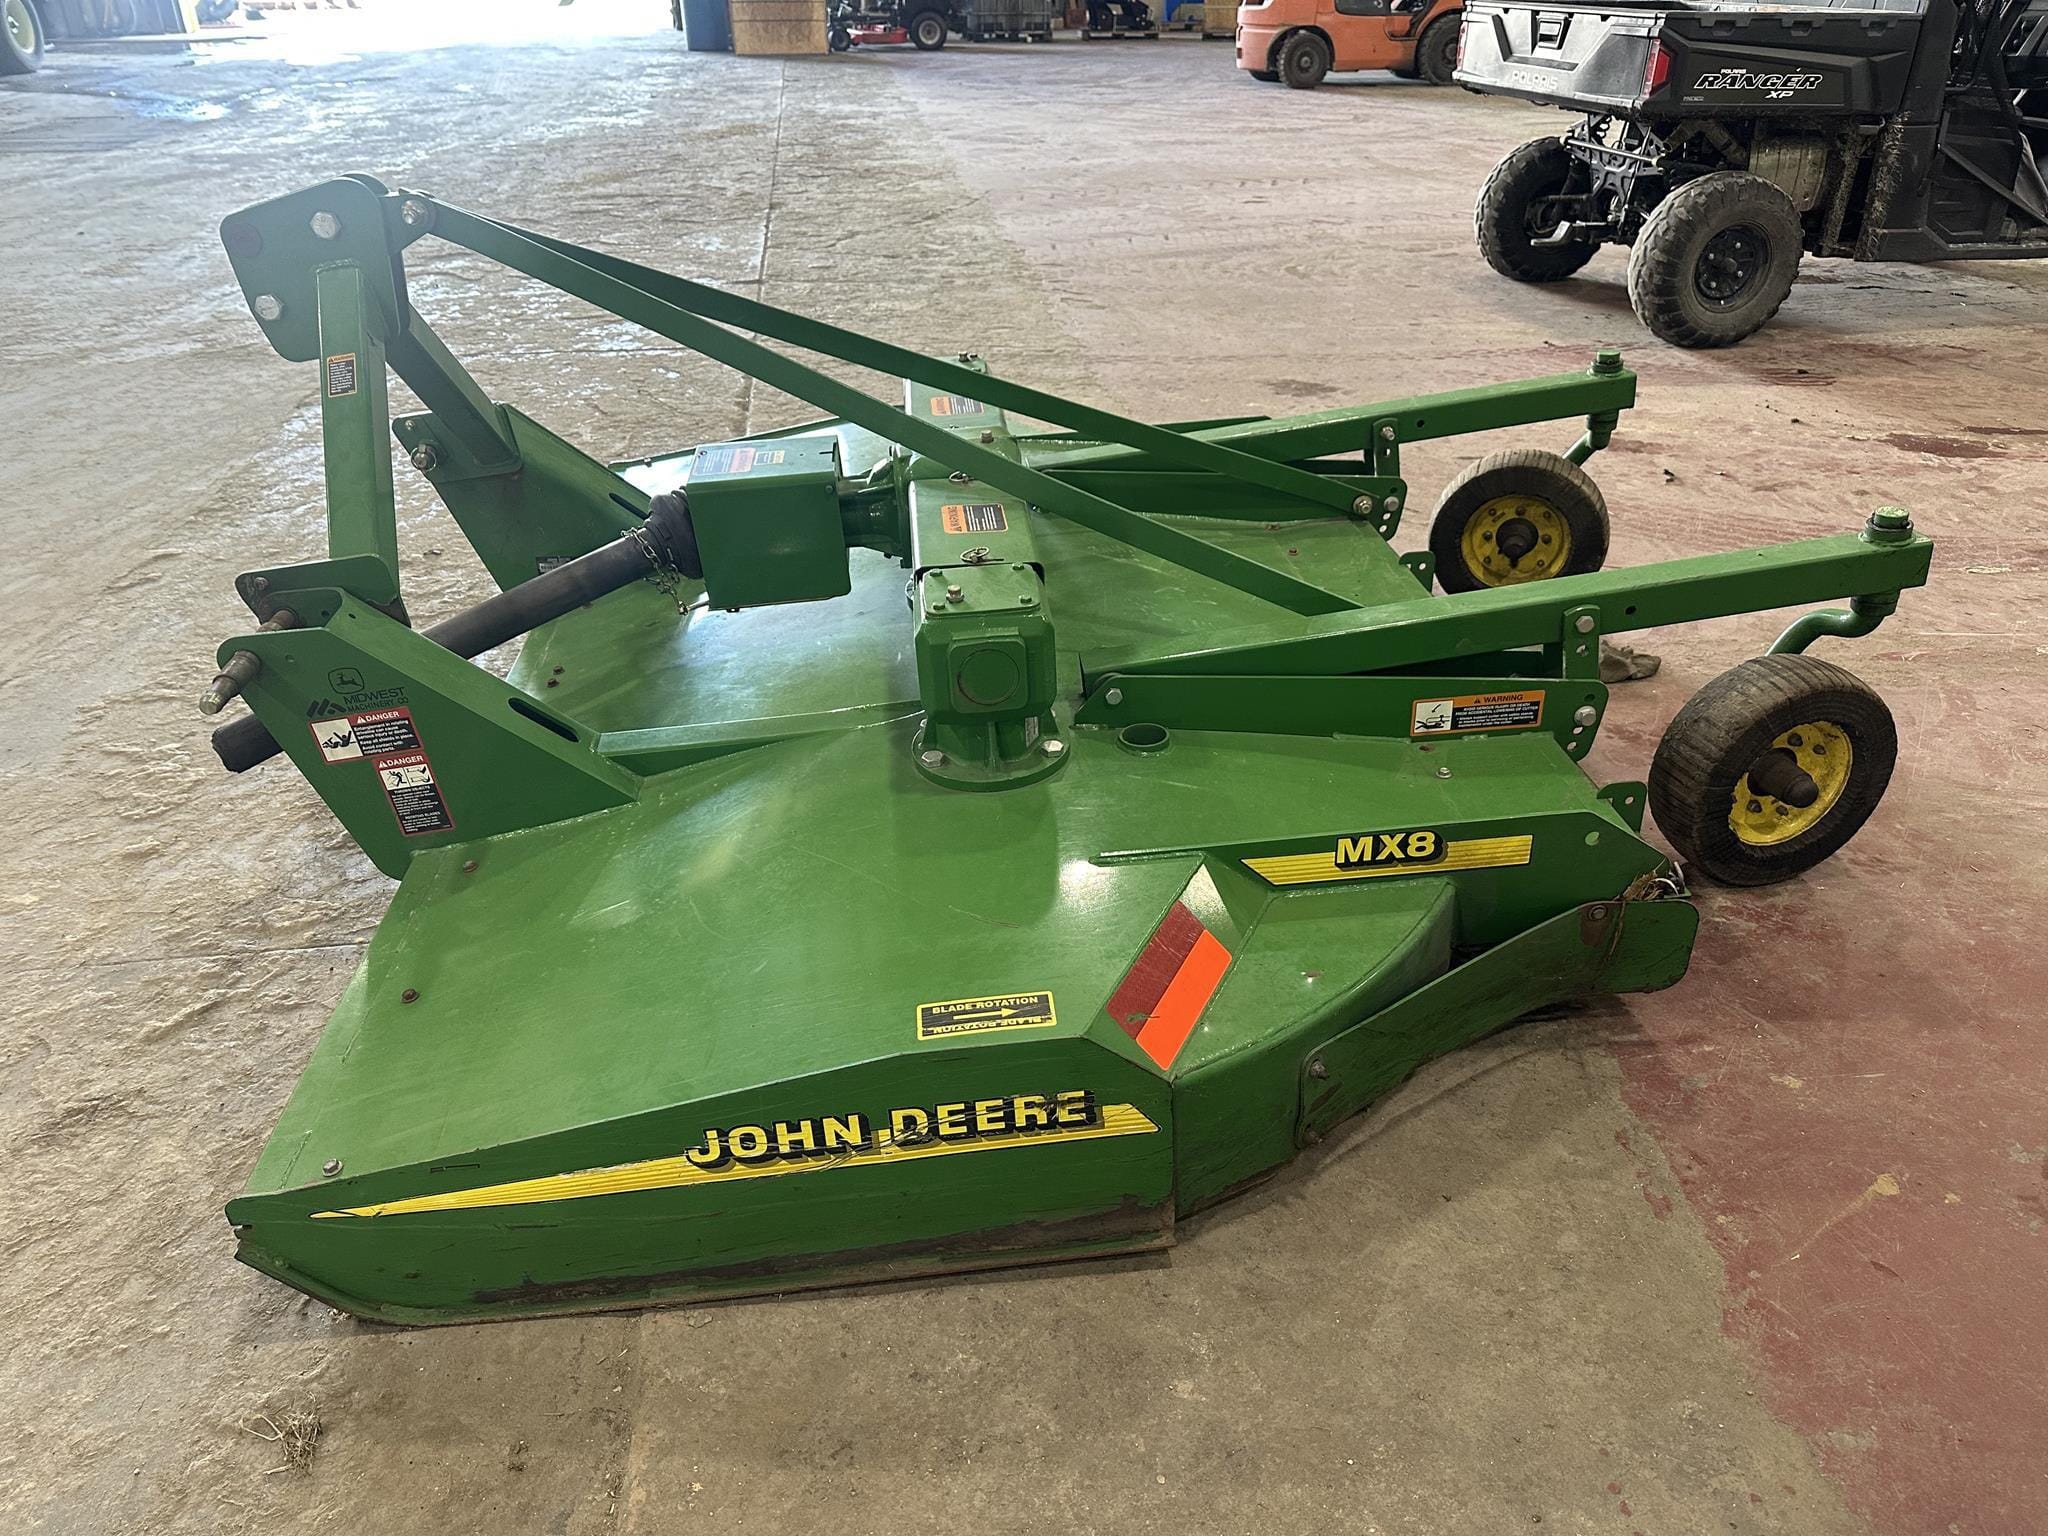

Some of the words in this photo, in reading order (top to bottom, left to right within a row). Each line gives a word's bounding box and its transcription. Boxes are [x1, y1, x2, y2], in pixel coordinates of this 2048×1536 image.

[1511, 72, 1559, 90] POLARIS
[1693, 73, 1823, 89] RANGER
[1765, 90, 1794, 99] XP
[343, 687, 405, 705] MIDWEST
[1483, 694, 1523, 703] WARNING
[346, 700, 394, 711] MACHINERY
[365, 711, 400, 722] DANGER
[386, 755, 424, 767] DANGER
[1336, 831, 1436, 864] MX8
[932, 1003, 973, 1014] BLADE
[976, 996, 1038, 1008] ROTATION
[686, 1113, 863, 1165] JOHN
[887, 1089, 1089, 1137] DEERE
